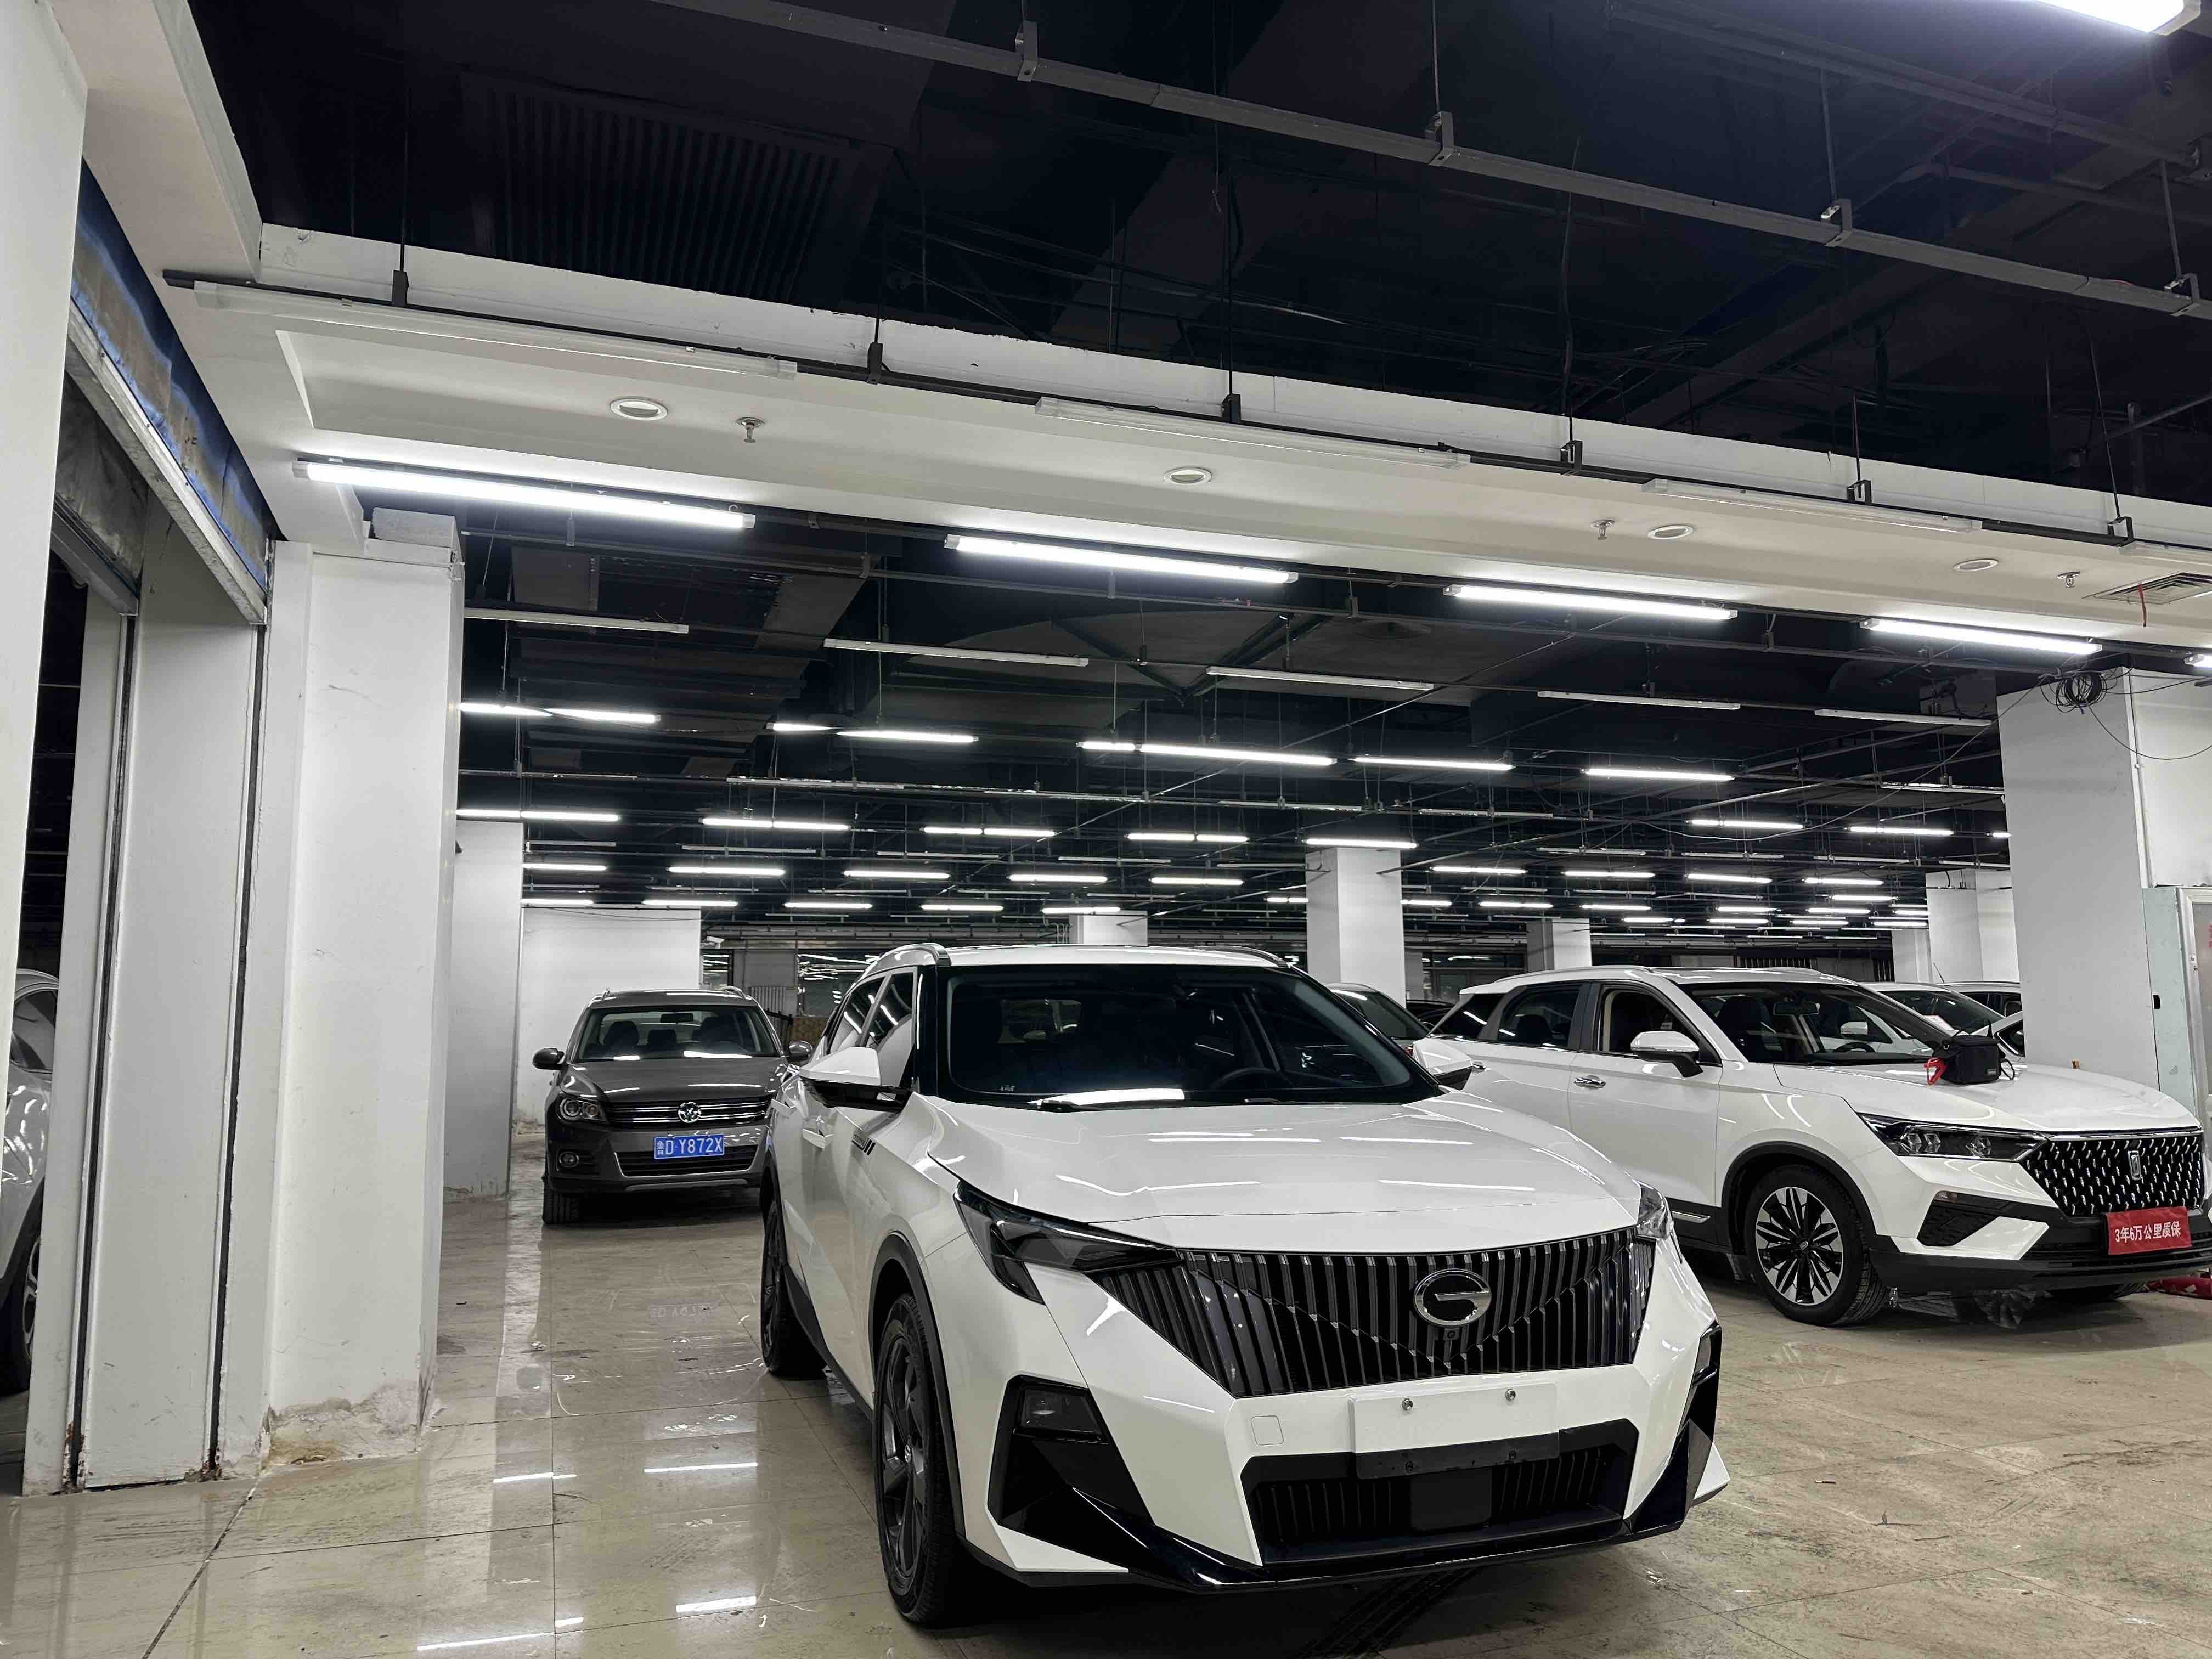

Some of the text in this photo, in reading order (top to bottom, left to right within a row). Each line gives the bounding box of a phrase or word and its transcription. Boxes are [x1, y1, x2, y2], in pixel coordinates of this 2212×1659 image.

[2114, 1221, 2181, 1243] 3年6万公里质保
